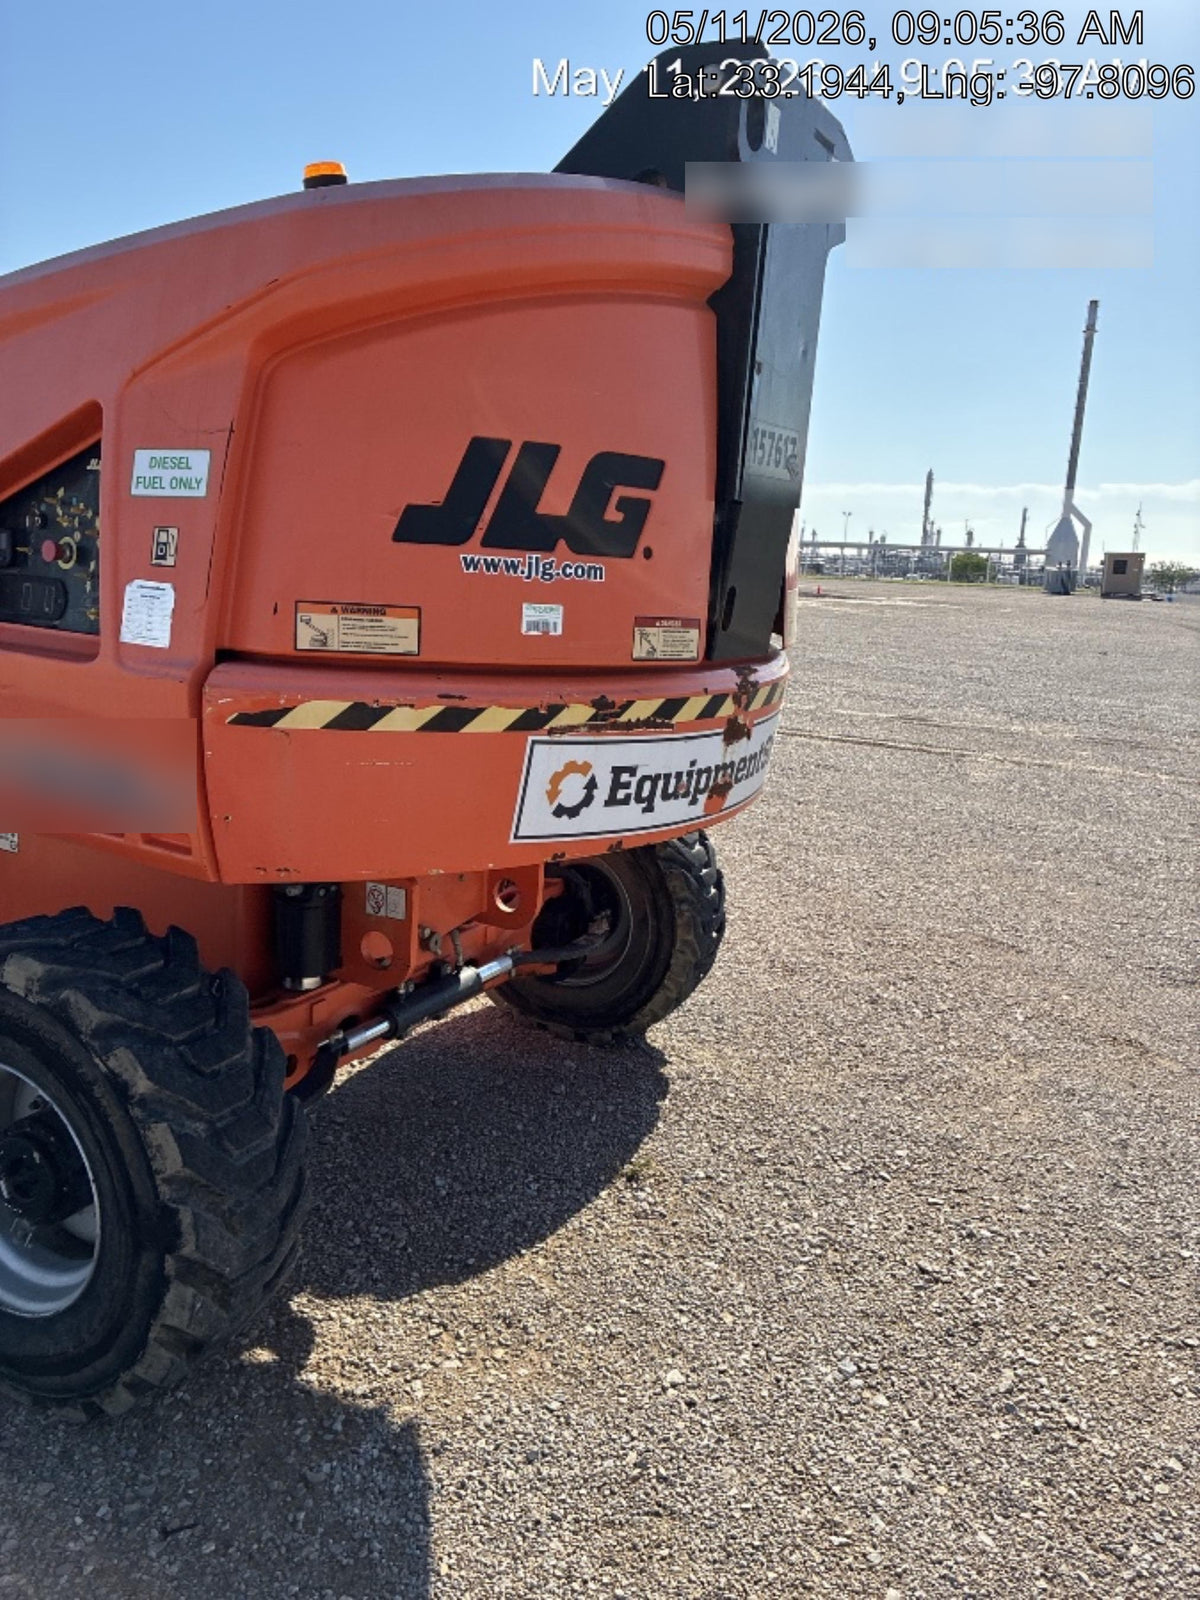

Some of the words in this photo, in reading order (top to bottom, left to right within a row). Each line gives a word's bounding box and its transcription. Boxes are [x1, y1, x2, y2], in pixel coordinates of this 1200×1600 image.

[149, 456, 193, 470] DIESEL
[135, 475, 166, 490] FUEL
[169, 475, 204, 490] ONLY
[460, 554, 605, 583] www.jlg.com
